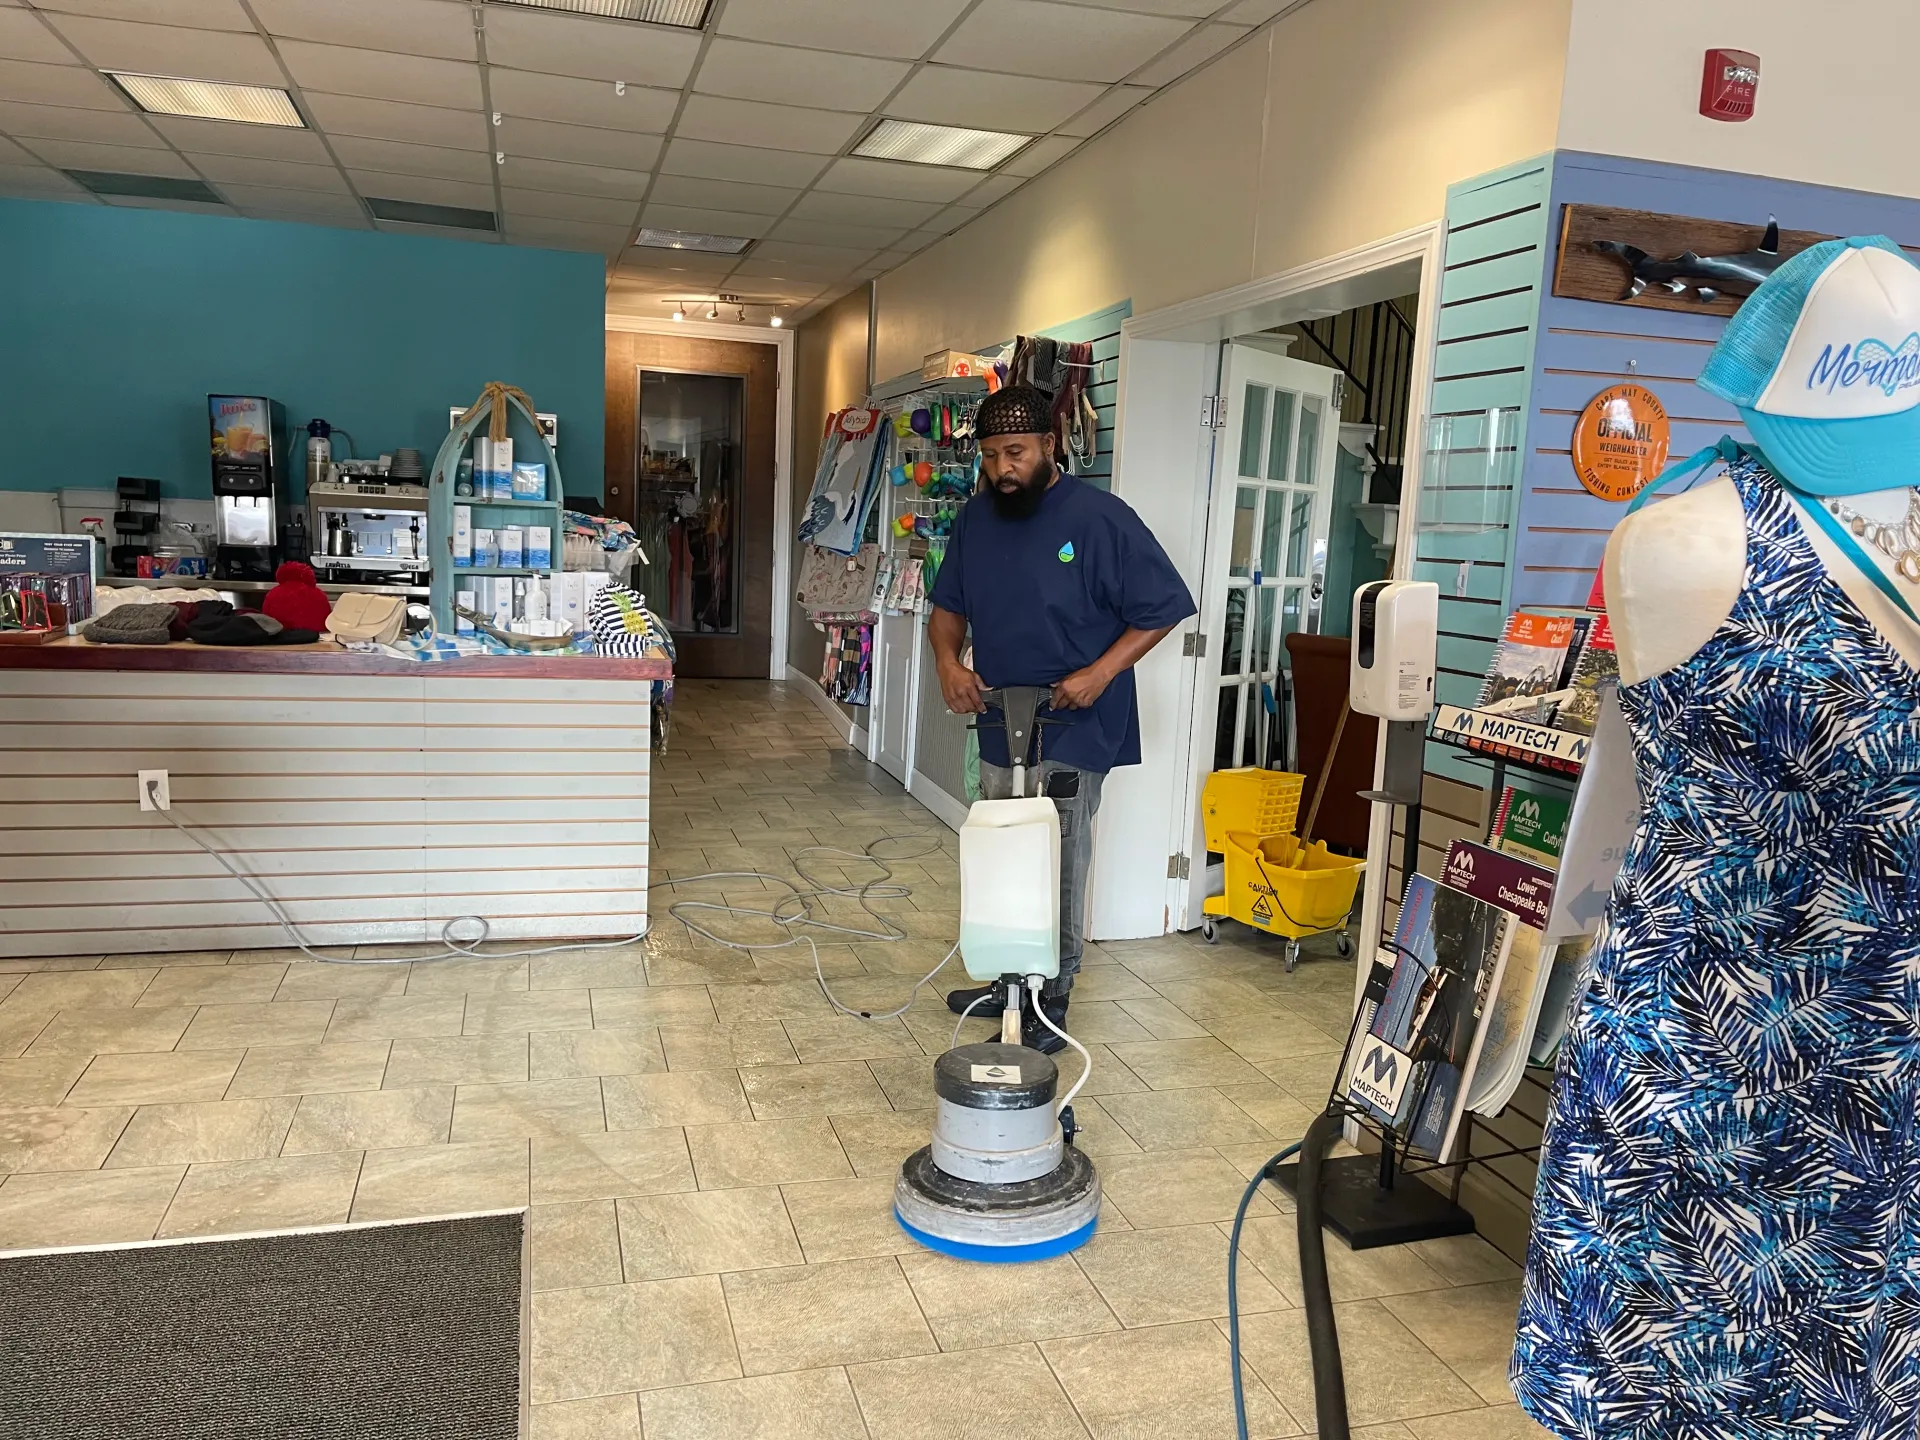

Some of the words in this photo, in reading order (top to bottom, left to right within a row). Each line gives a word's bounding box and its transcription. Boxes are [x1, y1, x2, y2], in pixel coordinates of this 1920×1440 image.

[1725, 85, 1751, 97] FIRE
[1595, 393, 1615, 411] CAPE
[1621, 388, 1638, 398] MAY
[1642, 392, 1665, 421] COUNTY
[1597, 417, 1653, 443] OFFICIAL
[1599, 442, 1648, 456] WEIGHMASTER
[1584, 468, 1611, 494] FISHING
[1616, 476, 1649, 497] CONTEST
[0, 557, 26, 565] aders
[1480, 718, 1561, 751] MAPTECH
[1511, 814, 1542, 830] MAPTECH
[1543, 831, 1562, 849] Cuttyh
[1447, 865, 1476, 881] MAPTECH
[1248, 881, 1278, 896] CAUTION
[1516, 877, 1538, 896] Lower
[1498, 885, 1536, 911] Chesapeake
[1535, 900, 1548, 919] Bay
[1353, 1076, 1394, 1110] MAPTECH
